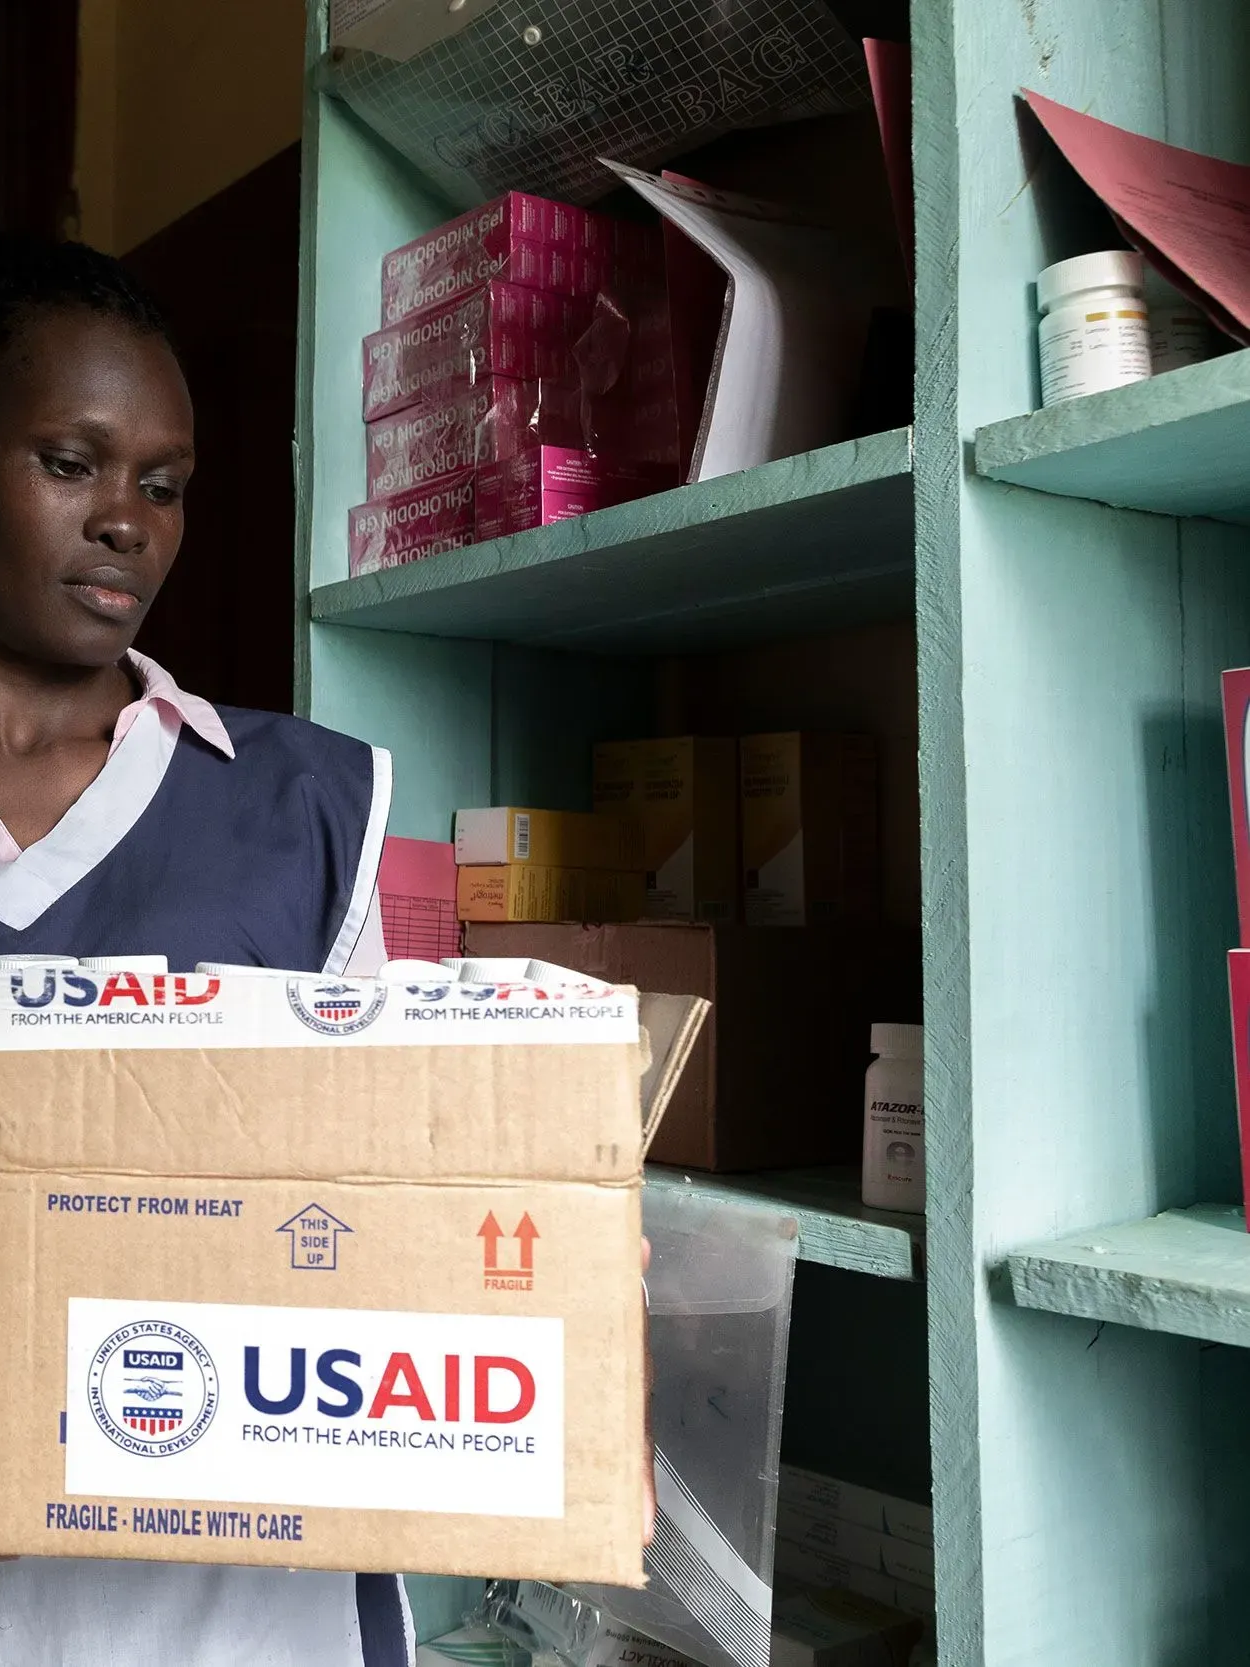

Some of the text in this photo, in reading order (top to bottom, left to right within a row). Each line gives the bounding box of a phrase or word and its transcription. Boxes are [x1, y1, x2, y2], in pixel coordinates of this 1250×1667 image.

[483, 27, 809, 150] CLEAR BAG
[387, 223, 475, 278] CHLORODIN
[478, 206, 504, 233] Gel
[387, 267, 473, 321] CHLORODIN
[477, 252, 503, 279] Gel
[355, 485, 474, 537] CHLORODIN Gel
[10, 968, 222, 1008] USAID
[11, 1010, 224, 1026] FROM THE AMERICAN PEOPLE
[404, 1006, 625, 1020] FROM THE AMERICAN PEOPLE
[47, 1194, 243, 1217] PROTECT FROM HEAT
[299, 1218, 329, 1231] THIS
[300, 1236, 329, 1249] SIDE
[306, 1253, 324, 1265] UP
[484, 1278, 533, 1292] FRAGILE
[96, 1323, 211, 1368] UNITED STATES AGENCY
[128, 1353, 178, 1367] USAID
[243, 1346, 536, 1424] USAID
[91, 1386, 156, 1454] INTERNATIONAL
[158, 1391, 216, 1454] DEVELOPMENT
[242, 1424, 536, 1454] FROM THE AMERICAN PEOPLE
[46, 1502, 118, 1532] FRAGILE
[132, 1507, 201, 1536] HANDLE
[206, 1511, 251, 1539] WITH
[256, 1514, 303, 1541] CARE
